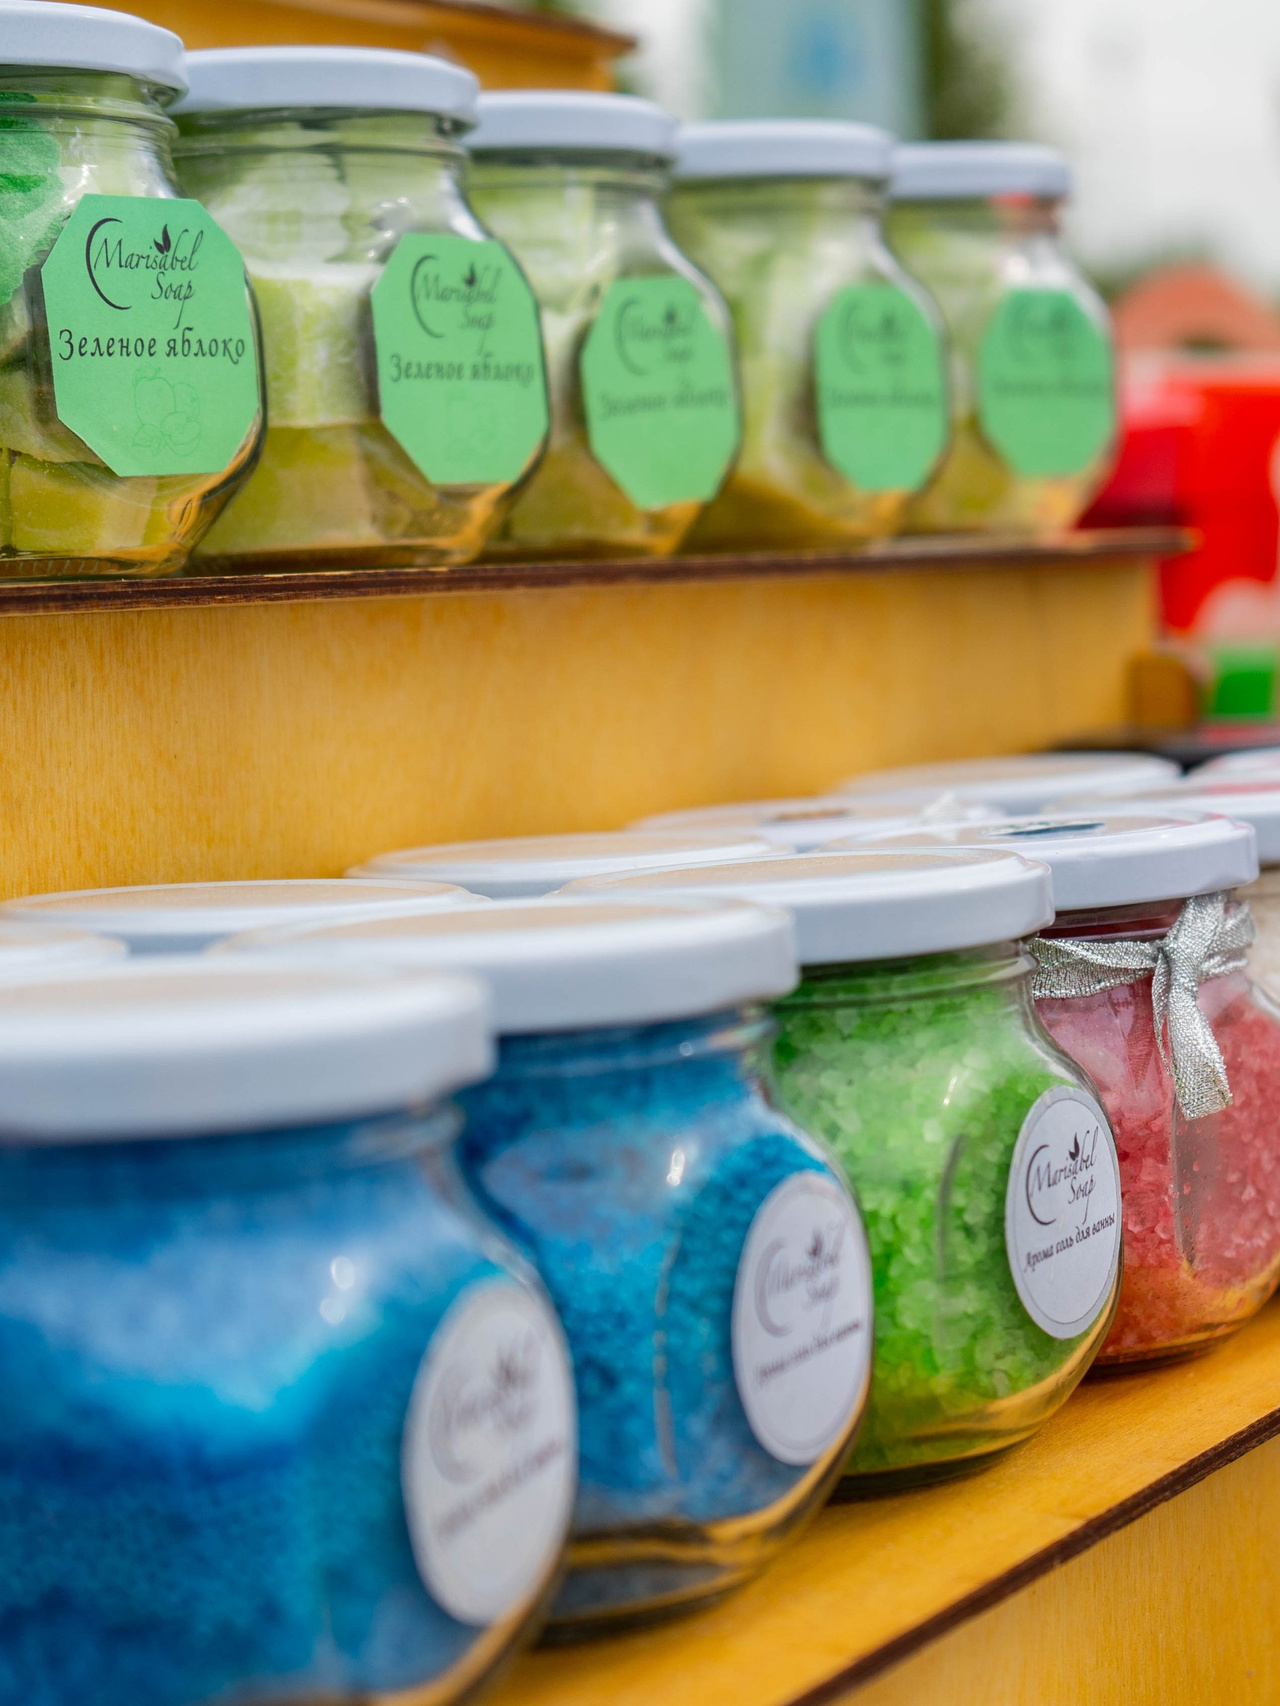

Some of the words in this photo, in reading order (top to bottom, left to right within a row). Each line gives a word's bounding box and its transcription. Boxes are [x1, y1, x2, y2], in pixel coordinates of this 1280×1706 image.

[94, 229, 204, 271] Marisabel
[150, 271, 196, 330] Soap
[58, 328, 157, 361] Зеленое
[165, 327, 246, 365] яблоко
[1029, 1126, 1099, 1199] Marisabel
[1067, 1174, 1097, 1226] Soap
